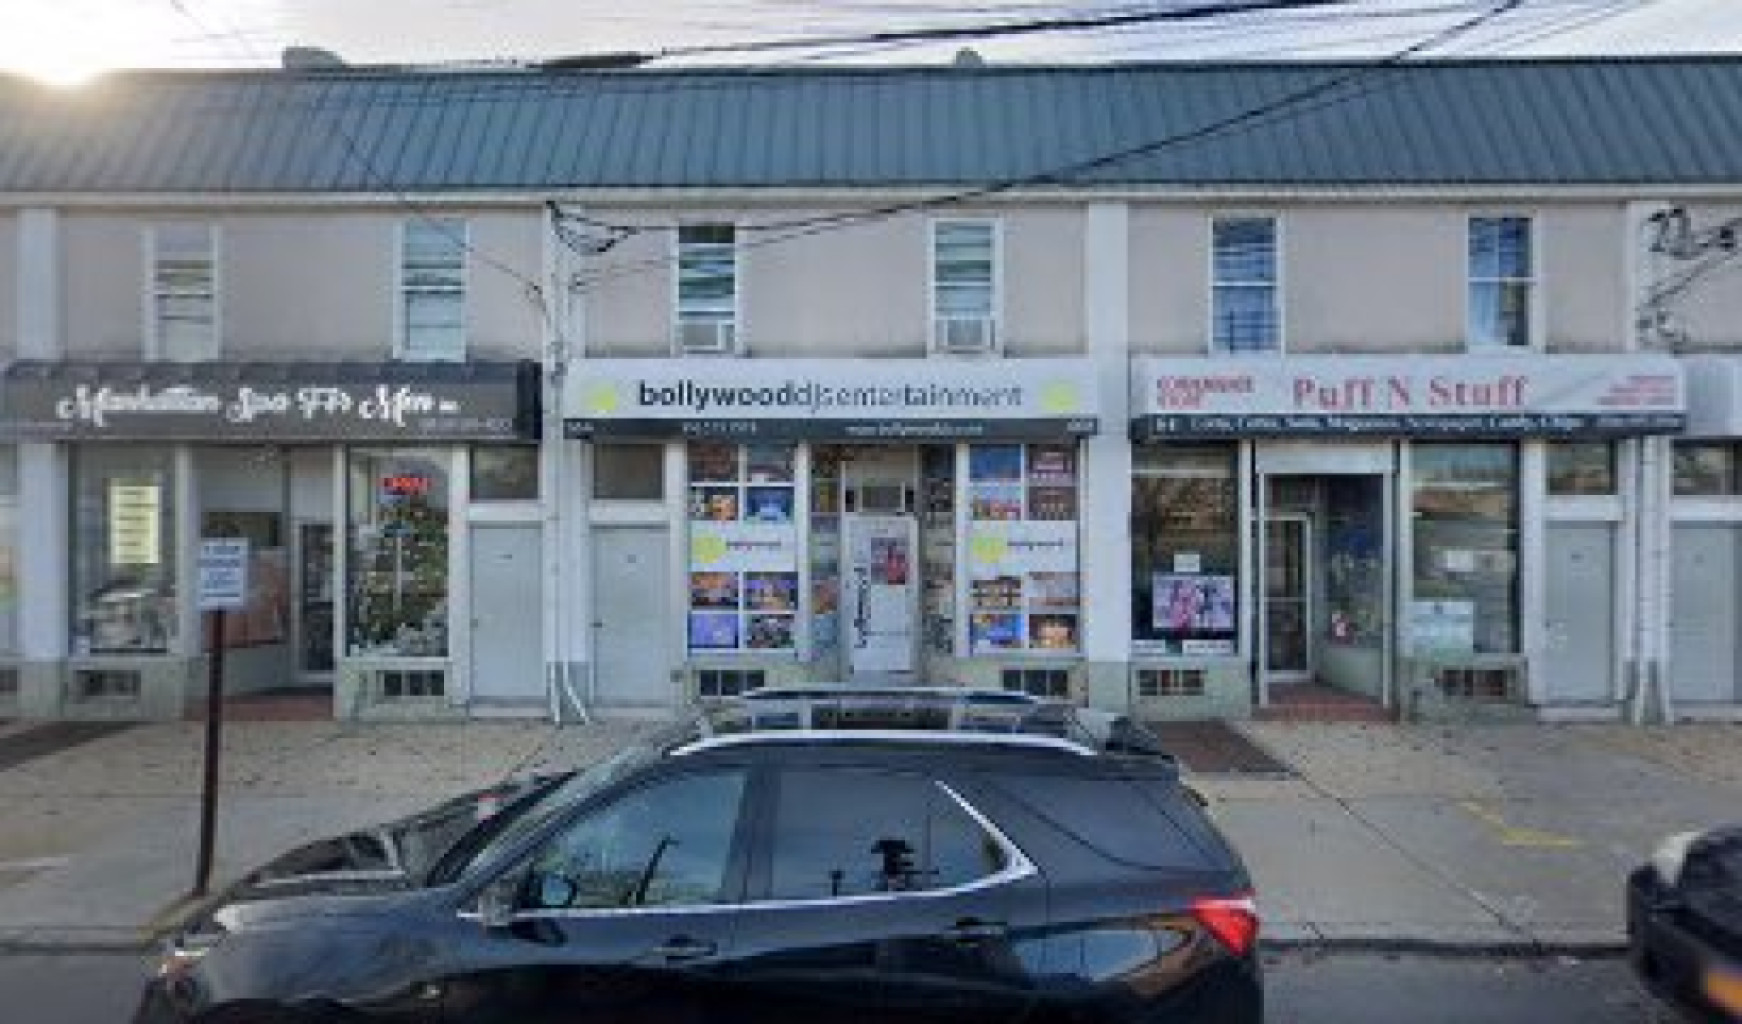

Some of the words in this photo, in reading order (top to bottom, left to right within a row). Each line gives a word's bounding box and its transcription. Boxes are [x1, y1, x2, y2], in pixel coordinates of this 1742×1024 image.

[55, 384, 220, 427] Manhattan
[225, 386, 288, 422] Spa
[357, 384, 434, 428] Men
[1292, 376, 1374, 409] Puff
[1387, 376, 1410, 409] N
[1428, 375, 1532, 407] Stuff
